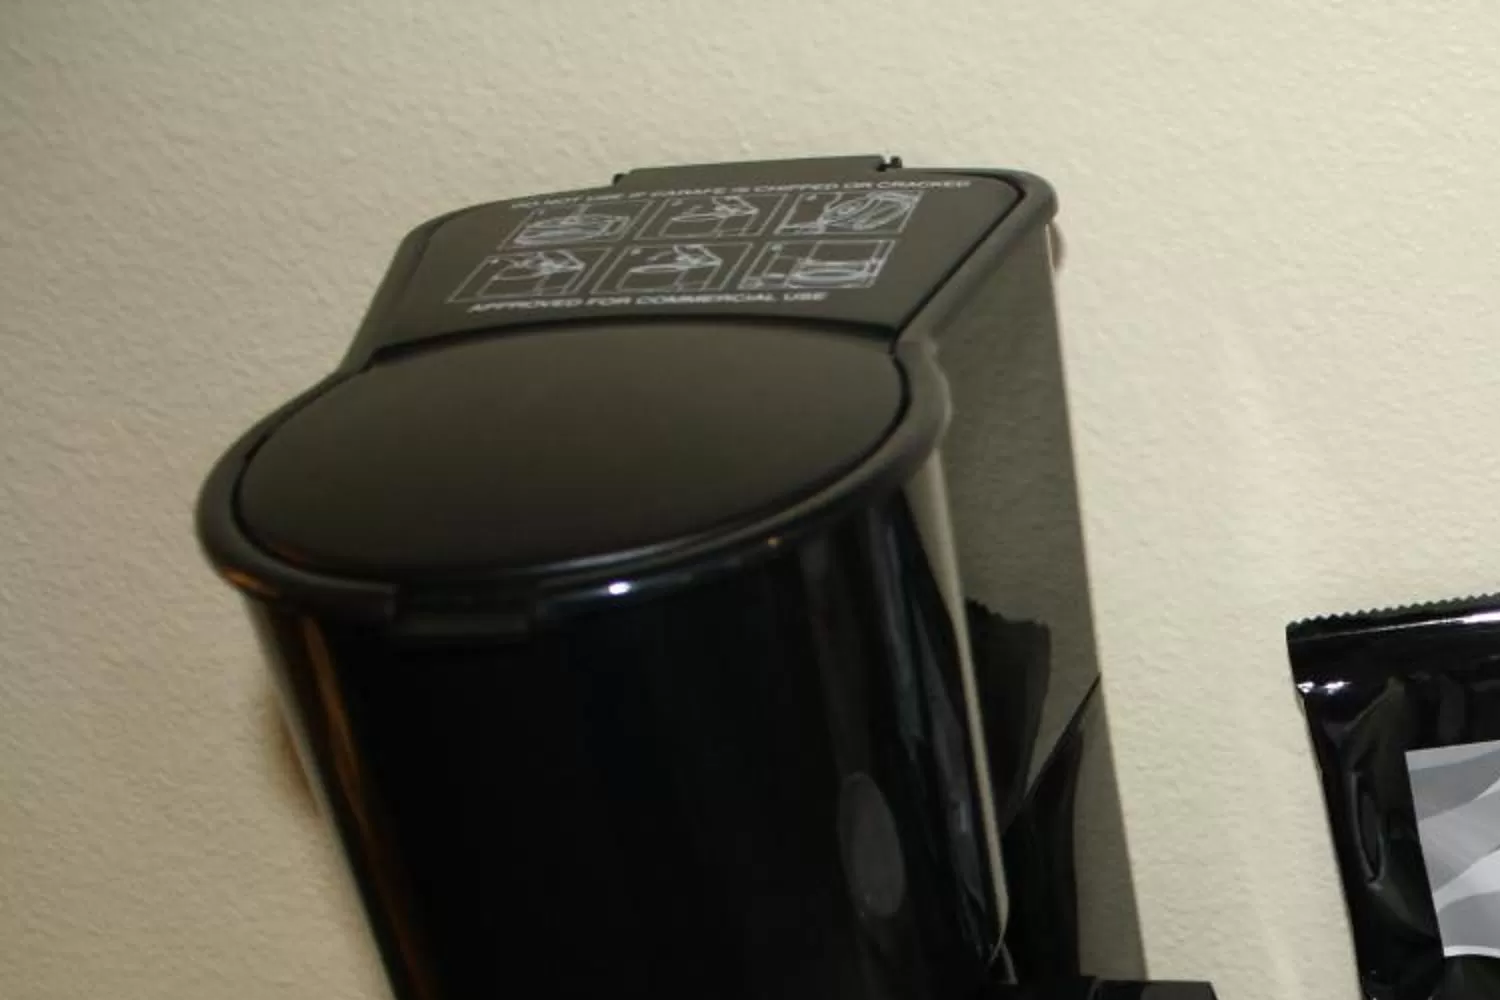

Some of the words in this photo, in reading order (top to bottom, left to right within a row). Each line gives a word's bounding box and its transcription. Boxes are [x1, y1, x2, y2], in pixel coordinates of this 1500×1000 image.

[466, 297, 583, 313] APPROVED
[585, 295, 632, 305] FOR
[635, 292, 775, 305] COMMERCIAL
[783, 291, 830, 301] USE
